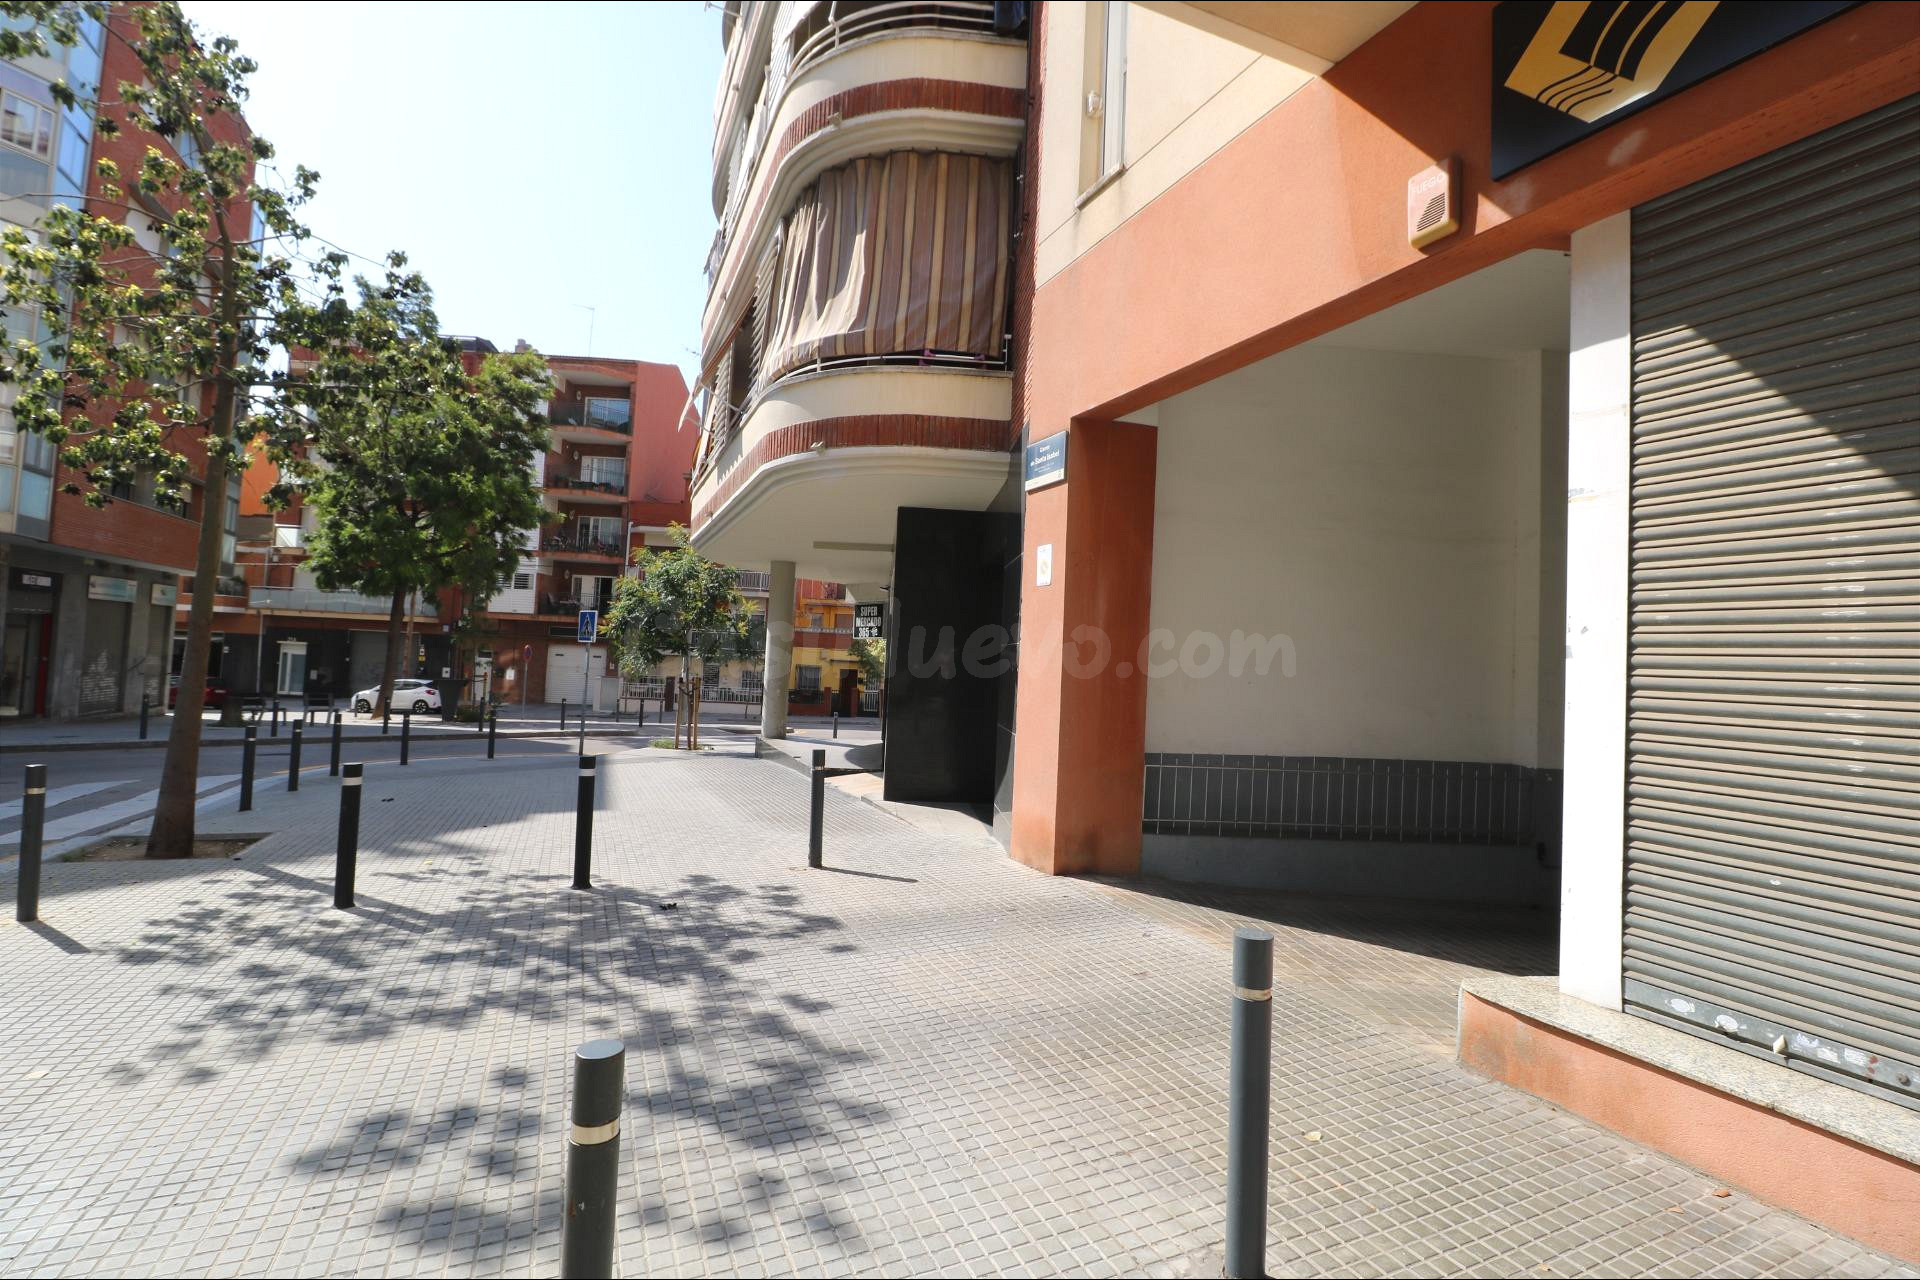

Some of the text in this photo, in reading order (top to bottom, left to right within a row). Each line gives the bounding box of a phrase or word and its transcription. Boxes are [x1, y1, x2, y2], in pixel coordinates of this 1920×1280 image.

[1411, 174, 1446, 194] FUEGO
[860, 606, 878, 617] SUPER
[855, 616, 882, 628] MERCADO
